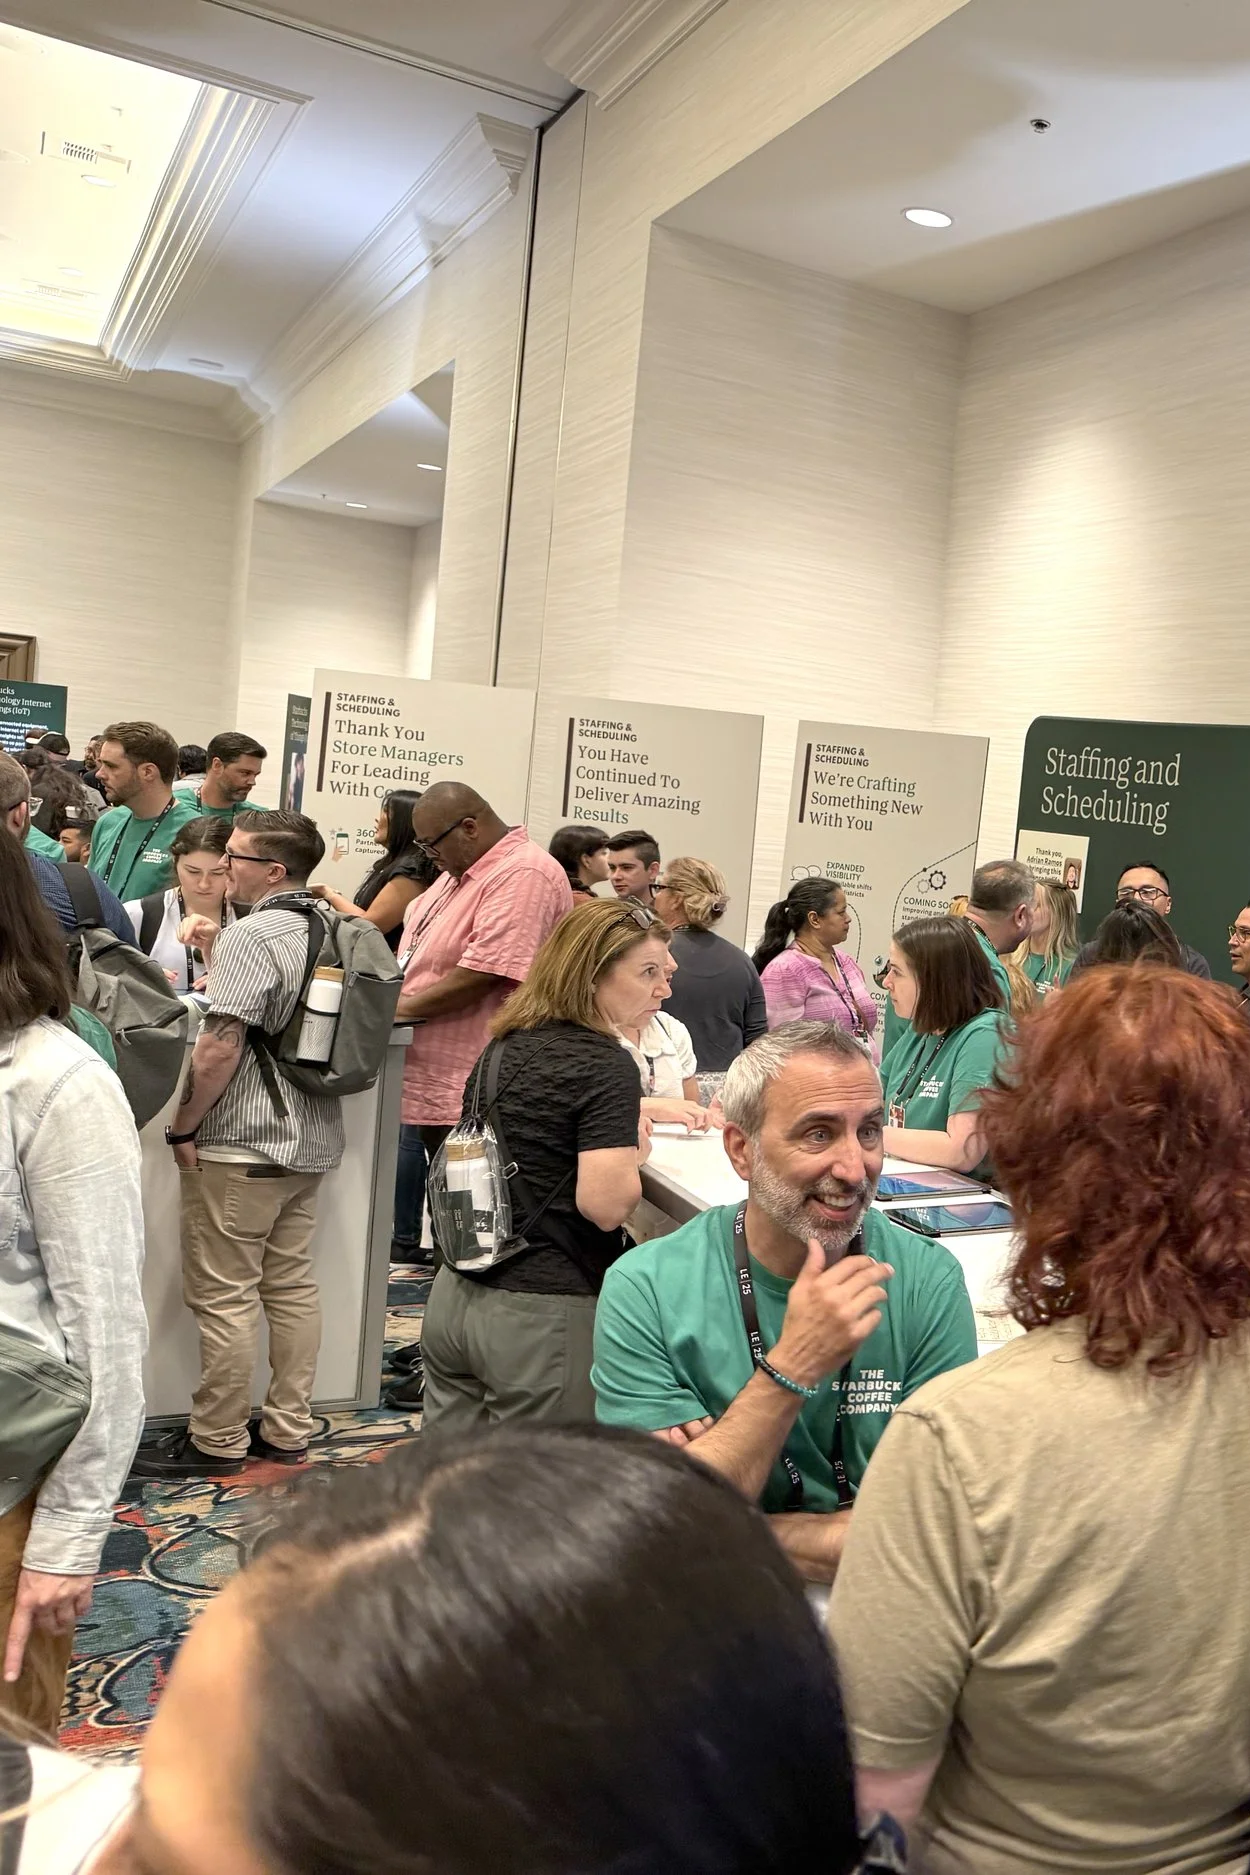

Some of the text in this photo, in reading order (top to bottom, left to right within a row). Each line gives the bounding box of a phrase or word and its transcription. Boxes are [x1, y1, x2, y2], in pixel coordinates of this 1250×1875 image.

[22, 698, 52, 709] Internet
[336, 692, 395, 707] STAFFING &
[12, 706, 31, 717] (IoT)
[335, 703, 401, 718] SCHEDULING
[335, 719, 425, 742] Thank You
[578, 718, 633, 732] STAFFING &
[578, 728, 638, 743] SCHEDULING
[332, 739, 464, 767] Store Managers
[577, 745, 649, 766] You Have
[815, 743, 866, 757] STAFFING &
[814, 754, 870, 767] SCHEDULING
[331, 760, 431, 786] For Leading
[1045, 746, 1181, 790] Staffing and
[576, 765, 681, 789] Continued To
[814, 770, 917, 798] We're Crafting
[329, 780, 369, 798] With
[574, 785, 702, 816] Deliver Amazing
[810, 791, 924, 816] Something New
[573, 805, 629, 825] Results
[1041, 785, 1170, 836] Scheduling
[809, 811, 873, 831] With You
[354, 847, 386, 856] captured
[1035, 848, 1063, 859] Thank you,
[826, 861, 865, 873] EXPANDED
[1026, 856, 1063, 867] Adrian Ramos
[825, 870, 862, 881] VISIBILITY
[1051, 868, 1062, 876] this
[856, 883, 873, 891] shifts
[903, 896, 937, 908] COMING
[902, 906, 933, 917] Improving
[859, 1369, 884, 1380] THE
[831, 1381, 902, 1392] STARBUCK
[847, 1392, 892, 1403] COFFEE
[840, 1403, 899, 1414] COMPANY
